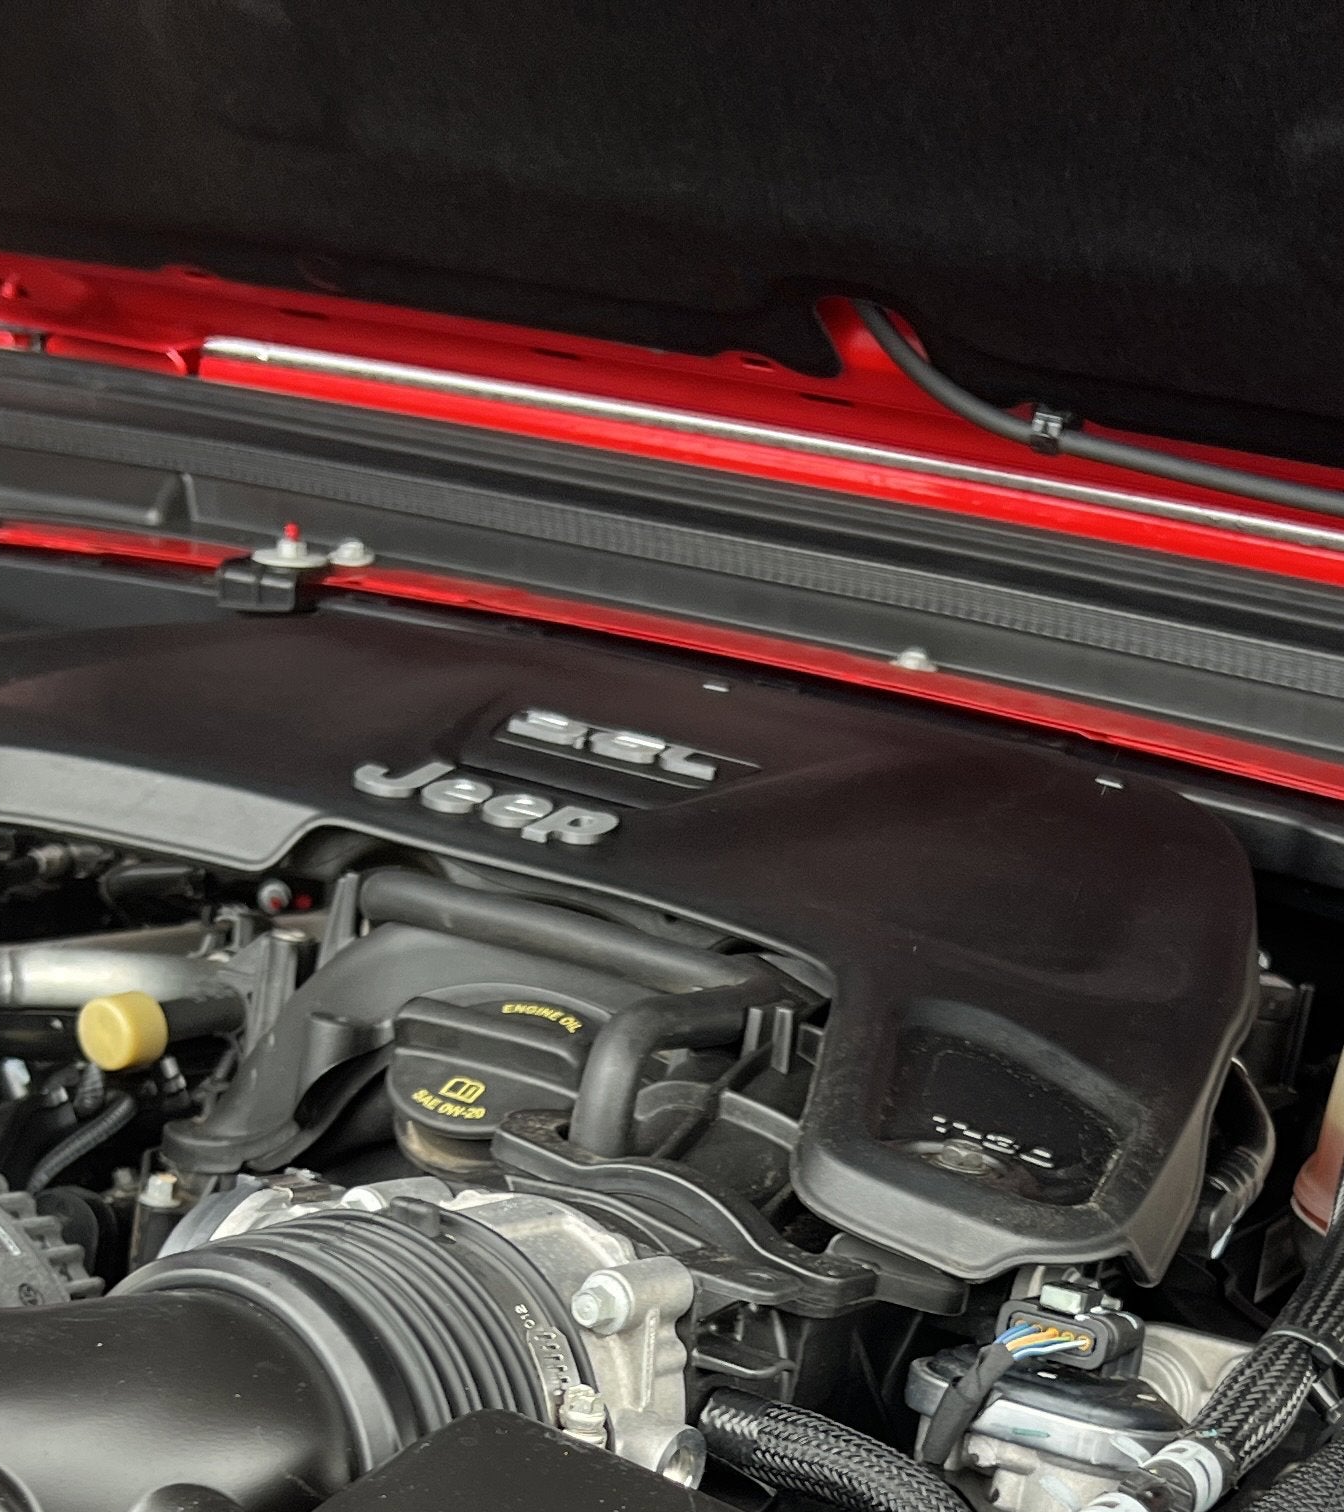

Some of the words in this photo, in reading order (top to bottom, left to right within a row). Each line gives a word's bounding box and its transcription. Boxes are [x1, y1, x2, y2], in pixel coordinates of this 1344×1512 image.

[353, 761, 620, 845] Jeep
[501, 1003, 565, 1022] ENGINE
[558, 1014, 583, 1034] OIL
[437, 1102, 486, 1120] 0W-20
